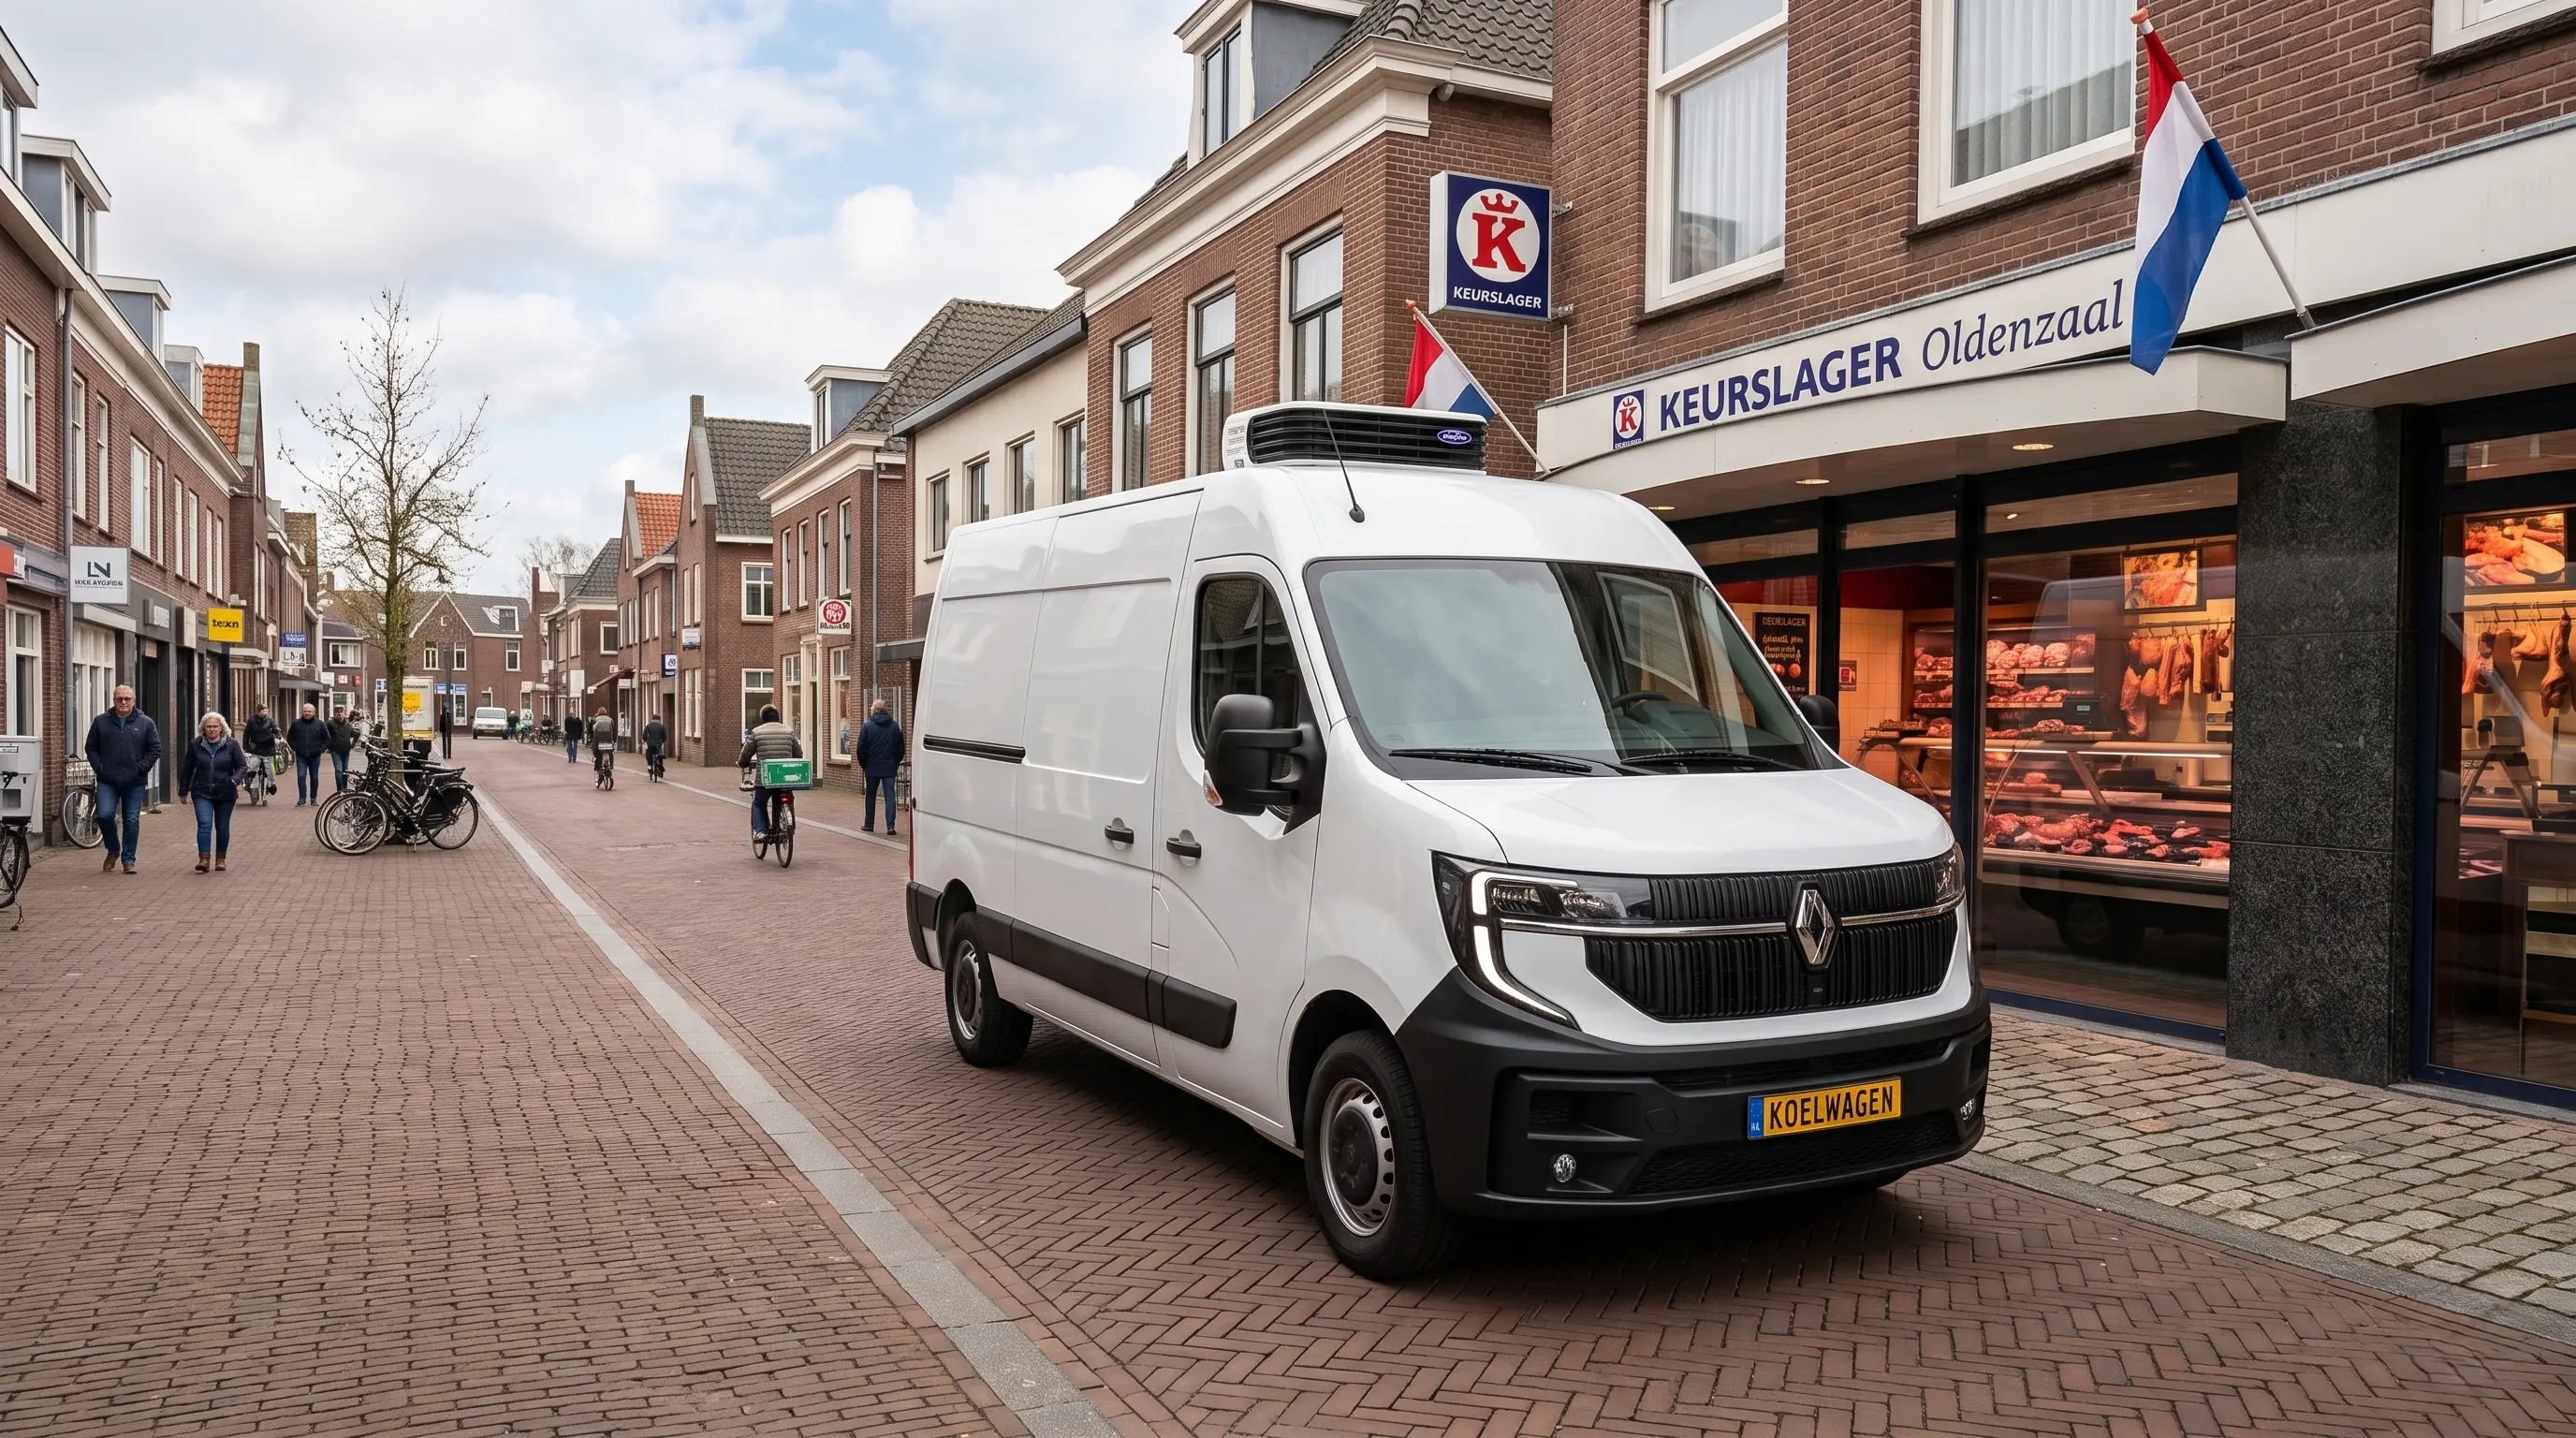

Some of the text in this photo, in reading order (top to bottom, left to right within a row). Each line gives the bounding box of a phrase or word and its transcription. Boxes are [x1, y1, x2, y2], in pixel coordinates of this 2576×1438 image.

[1472, 213, 1526, 272] K
[1453, 286, 1542, 309] KEURSLAGER
[1660, 278, 2123, 432] KEURSLAGER Oldenzaal
[1619, 405, 1638, 433] K
[1769, 1085, 1894, 1130] KOELWAGEN
